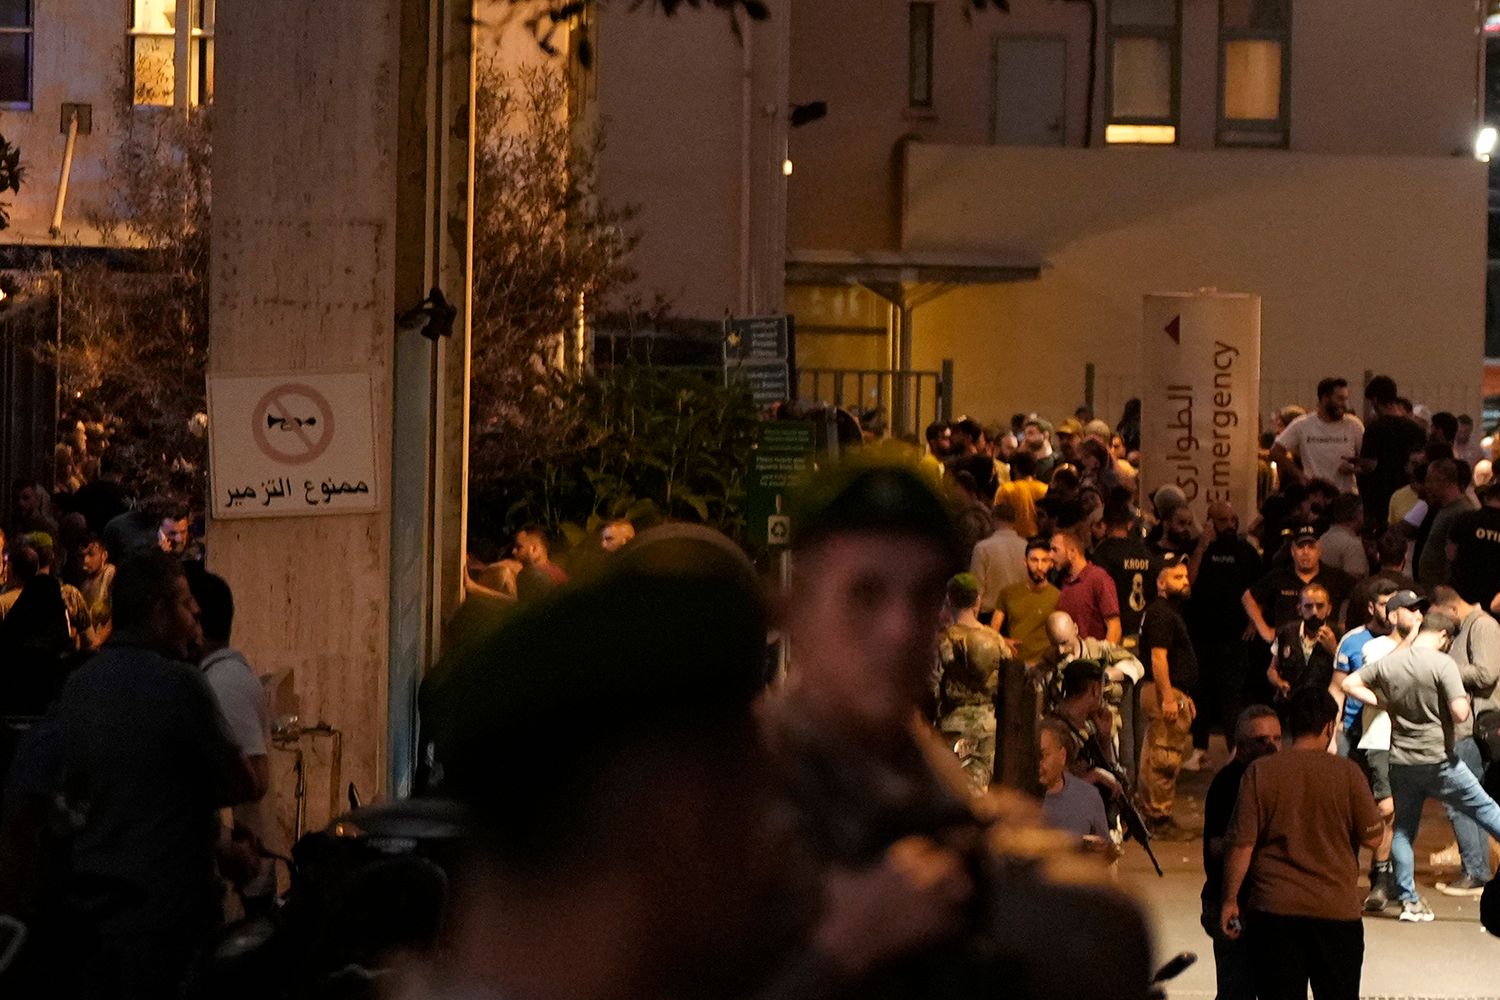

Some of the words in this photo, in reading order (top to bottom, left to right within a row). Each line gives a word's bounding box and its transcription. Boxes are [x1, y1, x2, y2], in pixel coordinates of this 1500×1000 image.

[1206, 340, 1240, 504] Emergency
[225, 477, 292, 507] التزمير
[303, 477, 369, 505] ممنوع
[1128, 573, 1146, 612] 8
